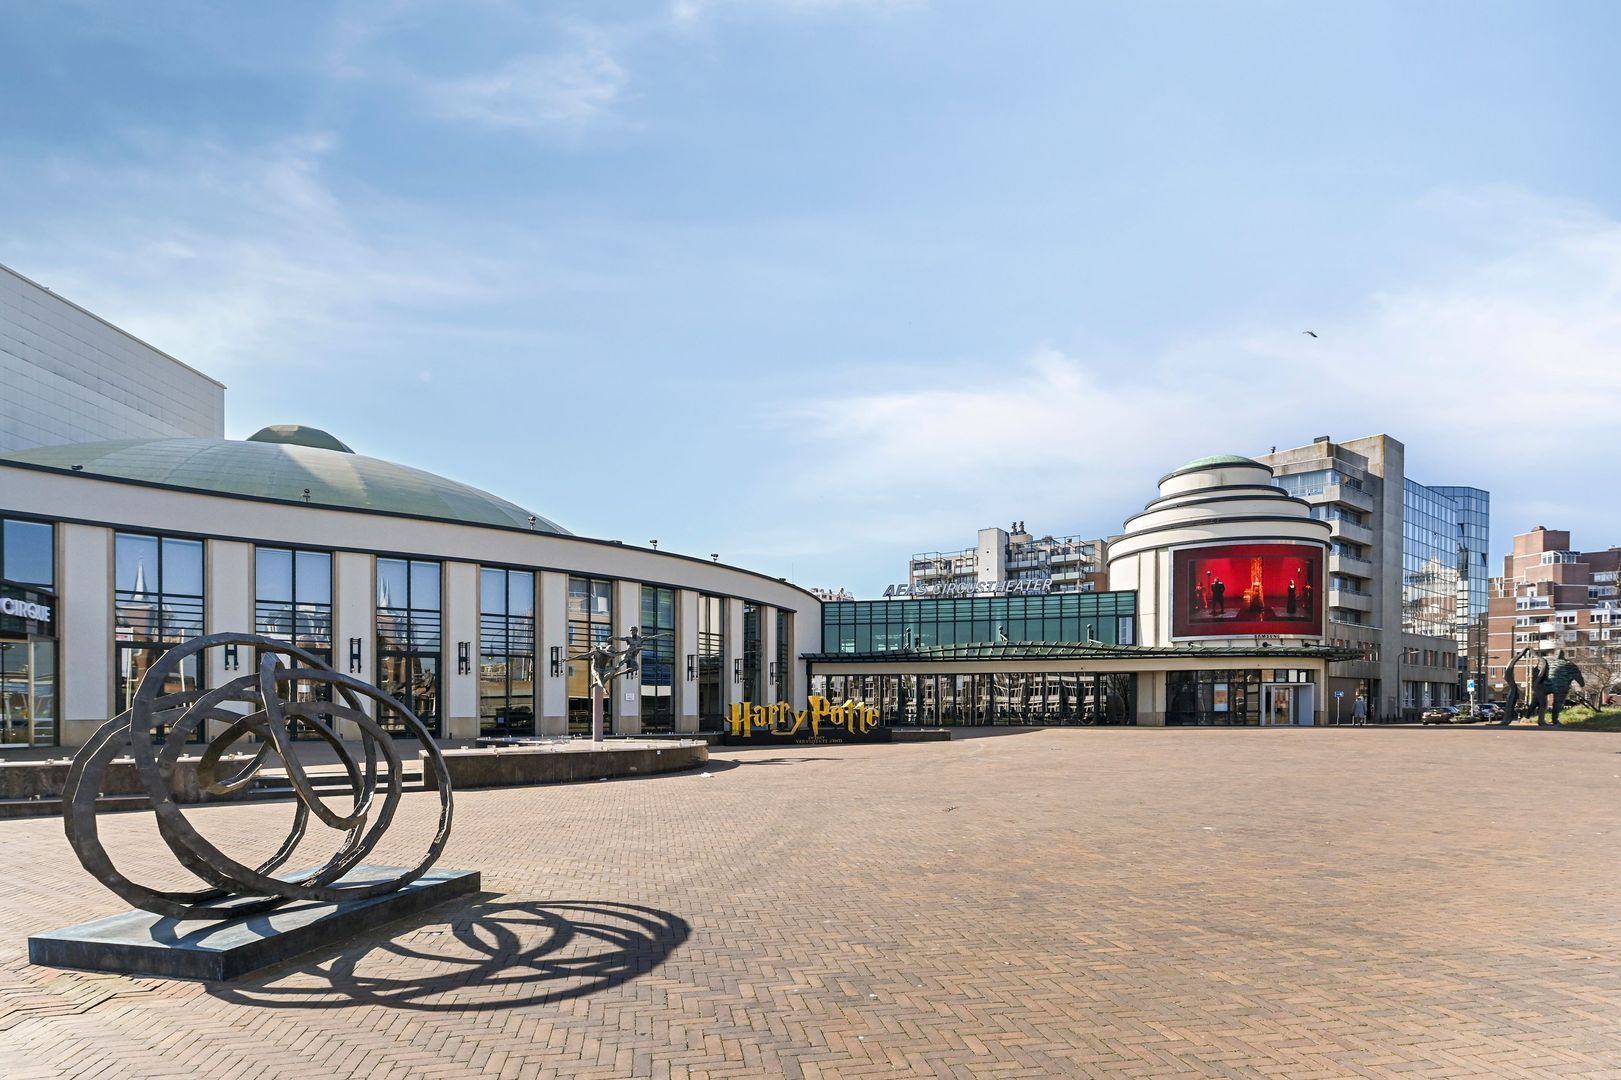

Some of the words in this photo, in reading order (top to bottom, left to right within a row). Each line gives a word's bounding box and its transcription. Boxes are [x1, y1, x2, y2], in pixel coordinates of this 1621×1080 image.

[882, 583, 929, 597] AFAS
[1, 597, 51, 622] CIRQUE
[725, 701, 808, 737] Harry
